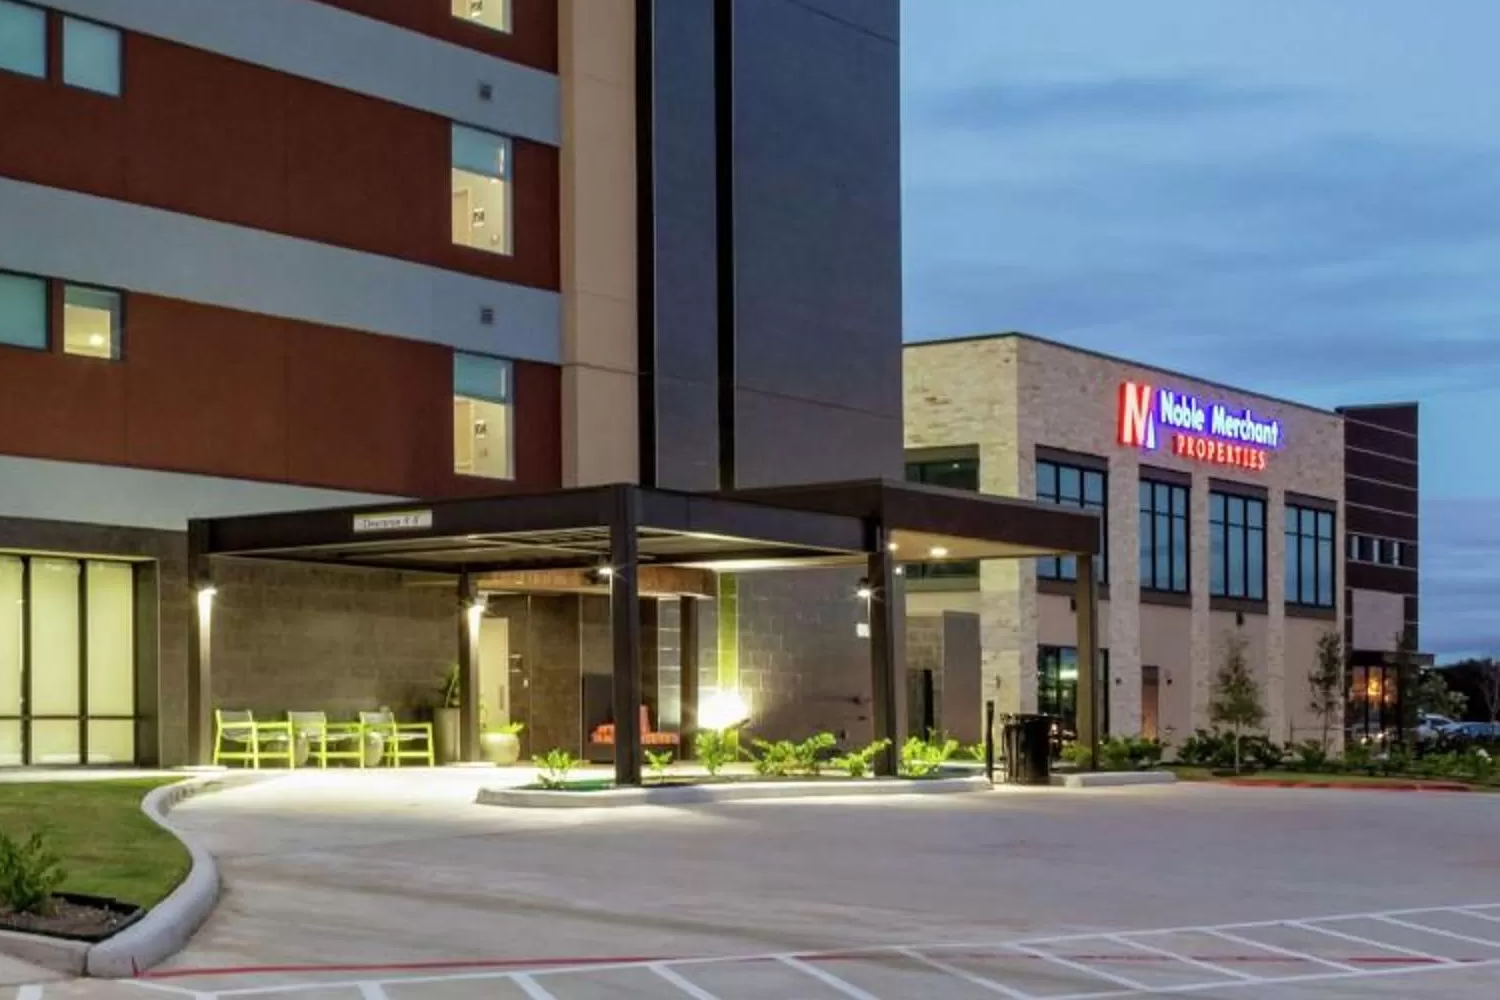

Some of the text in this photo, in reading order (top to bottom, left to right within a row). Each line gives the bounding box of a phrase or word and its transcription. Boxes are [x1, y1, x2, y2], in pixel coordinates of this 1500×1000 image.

[1159, 388, 1279, 447] Noble Merchant
[1174, 433, 1266, 471] PROPERTIES
